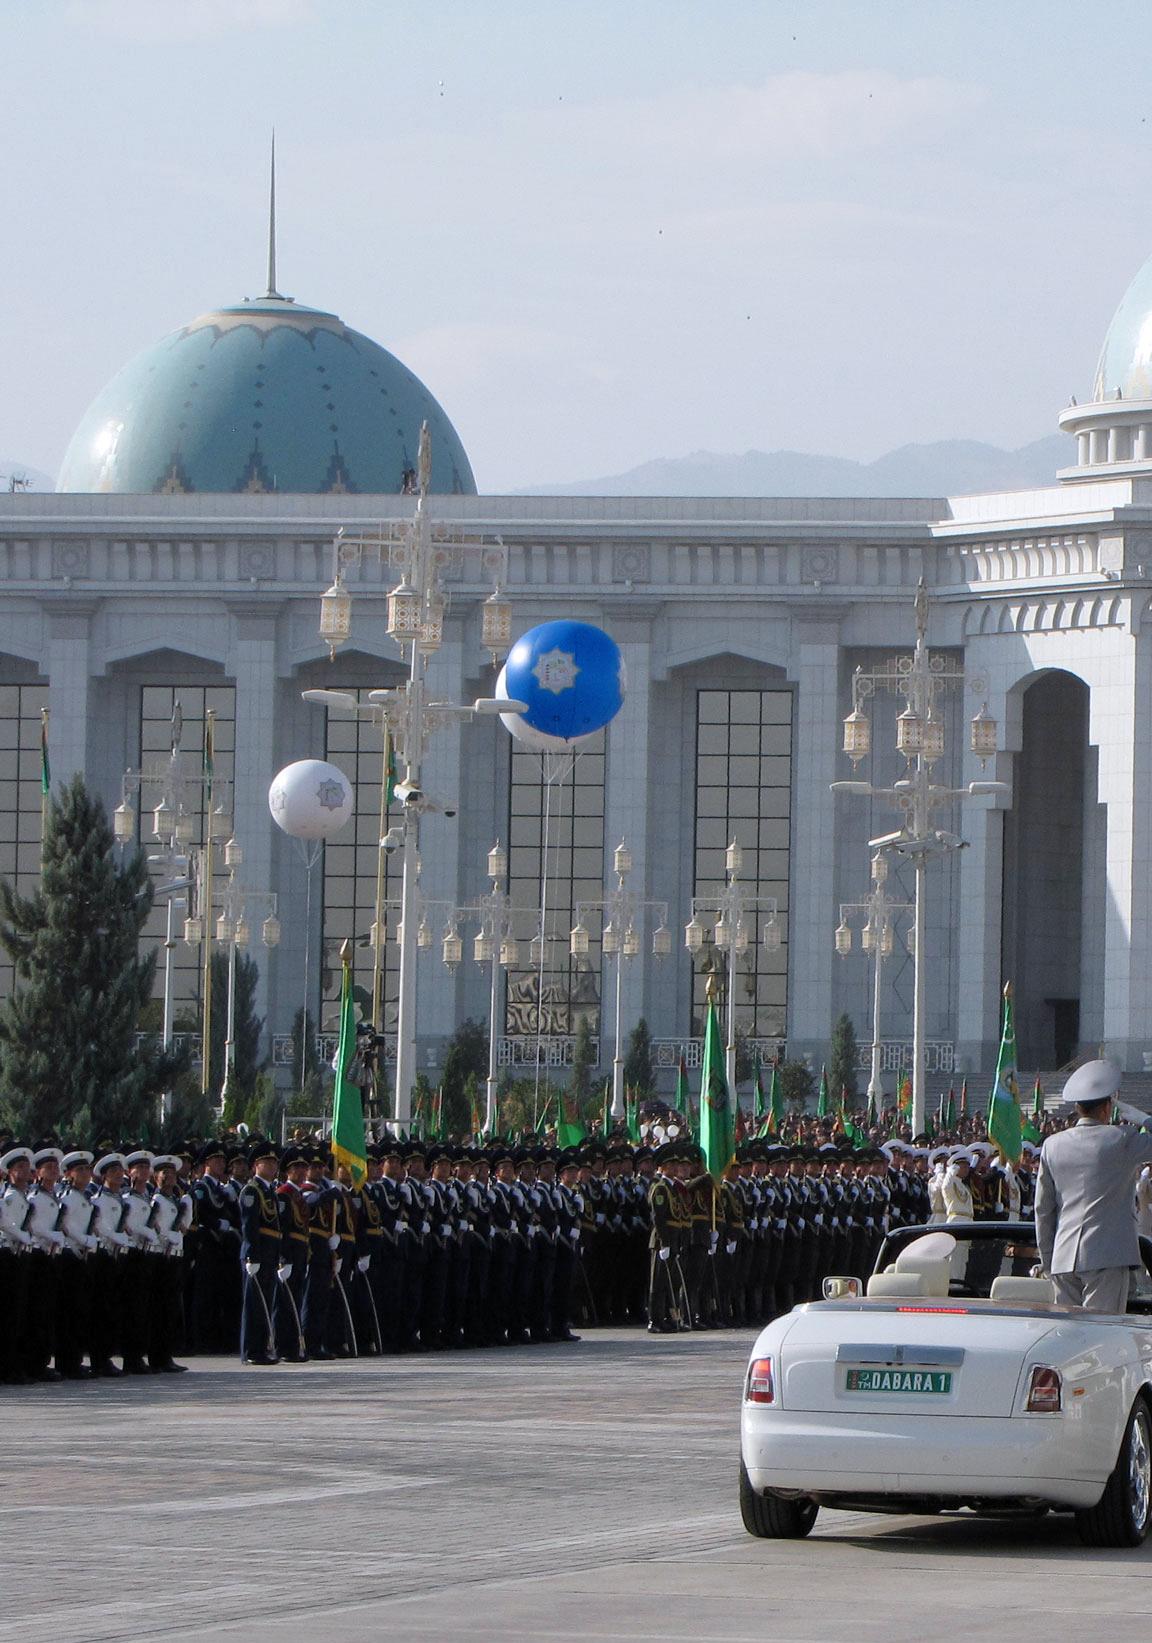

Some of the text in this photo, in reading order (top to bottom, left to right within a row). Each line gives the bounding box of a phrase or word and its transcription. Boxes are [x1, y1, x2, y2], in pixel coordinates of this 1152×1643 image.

[858, 1372, 946, 1392] TM DABARA 1
